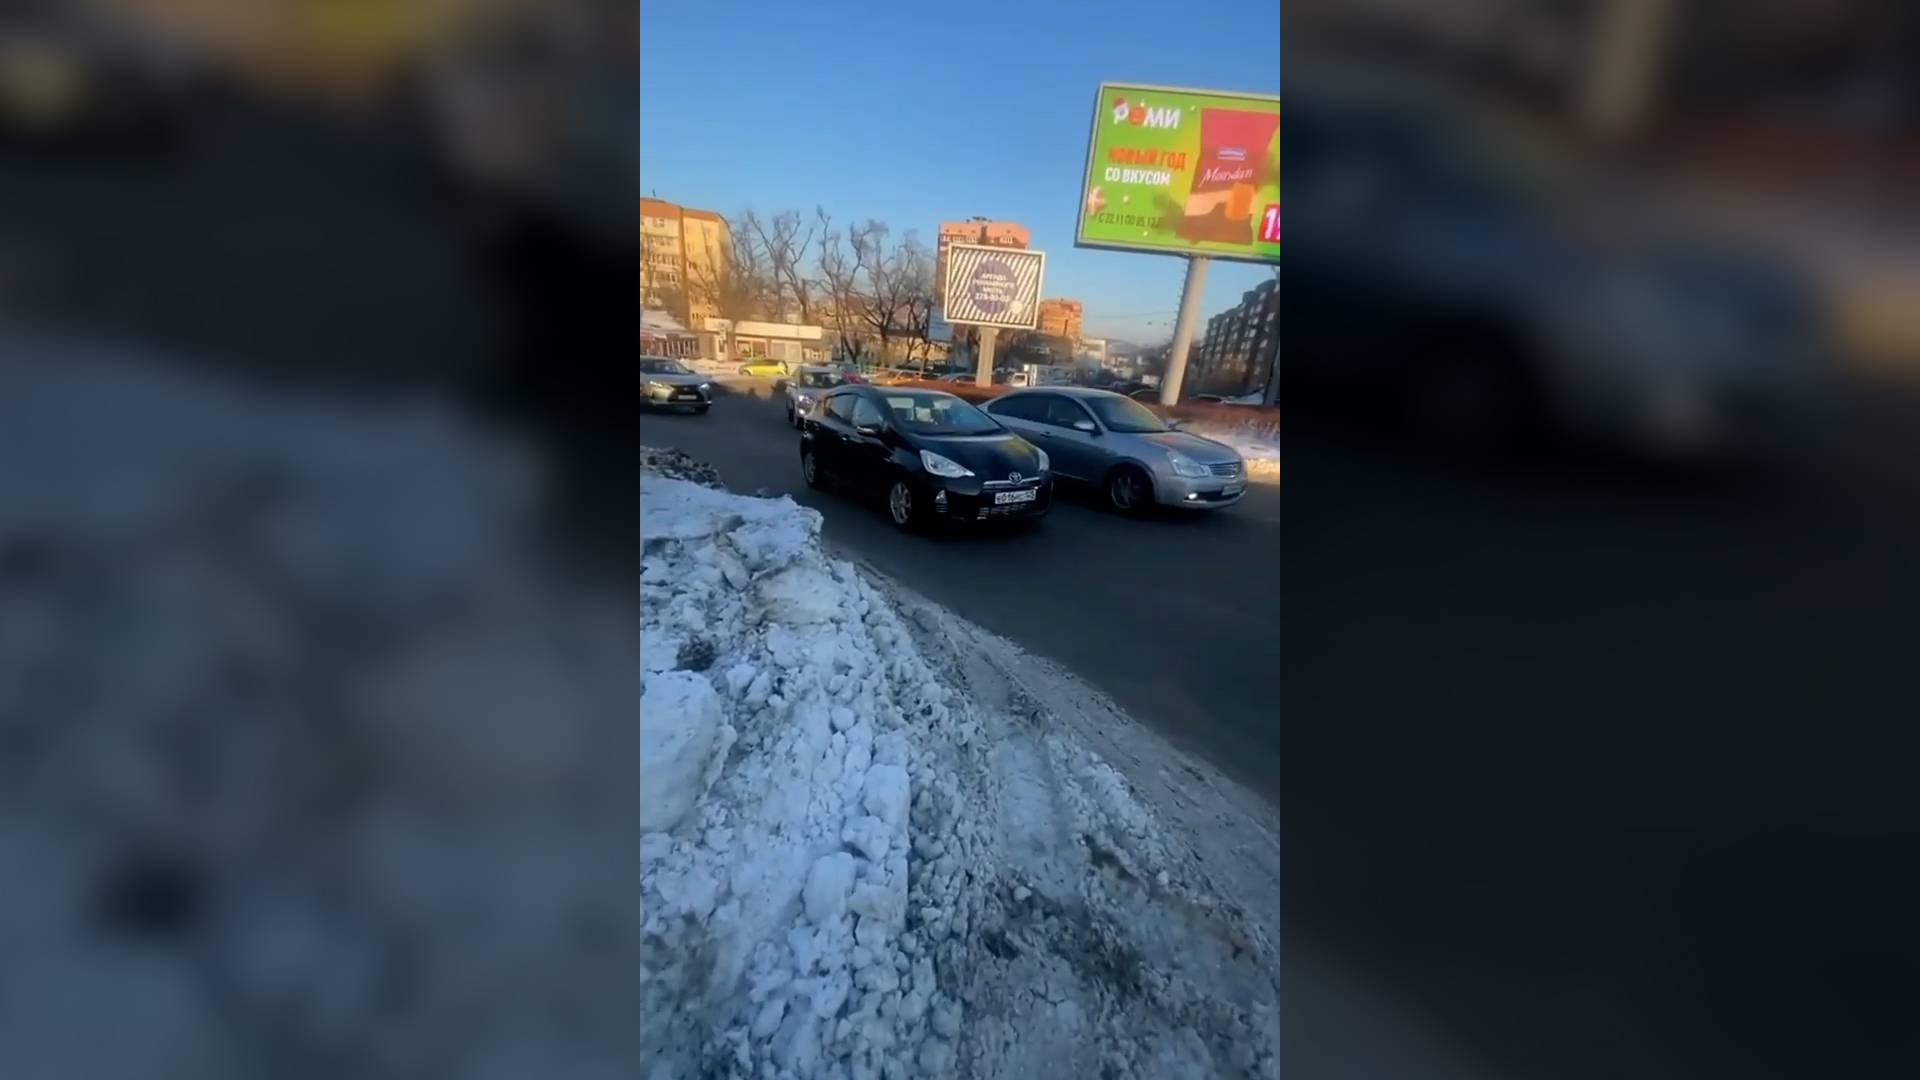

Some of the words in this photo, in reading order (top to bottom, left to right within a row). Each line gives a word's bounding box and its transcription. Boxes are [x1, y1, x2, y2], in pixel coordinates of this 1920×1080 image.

[1161, 152, 1186, 170] ГОД
[1105, 167, 1120, 182] СО
[1122, 169, 1171, 186] ВКУСОМ
[1264, 208, 1280, 240] 1
